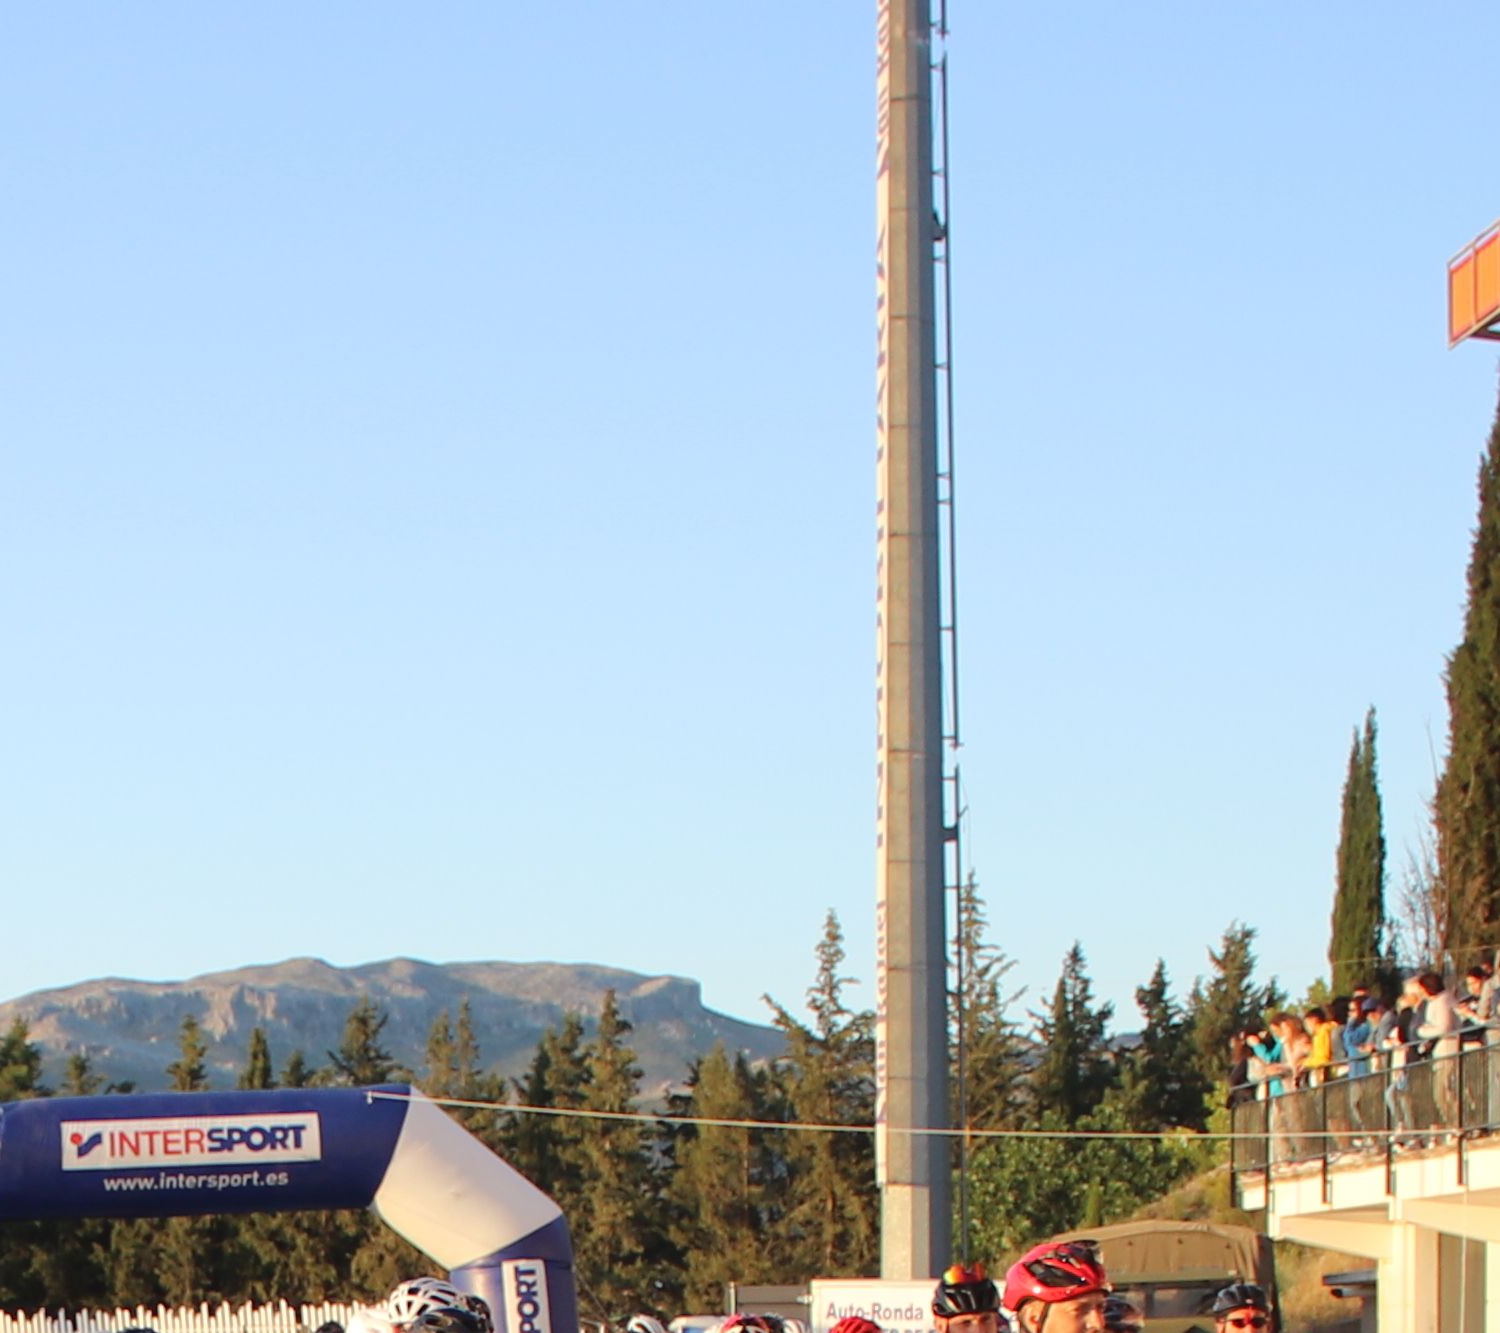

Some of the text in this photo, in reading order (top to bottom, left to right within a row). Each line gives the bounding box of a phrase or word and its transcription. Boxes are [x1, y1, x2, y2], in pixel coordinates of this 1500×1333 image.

[109, 1125, 307, 1159] INTERSPORT
[103, 1171, 290, 1193] www.intersport.es
[826, 1302, 924, 1322] Auto-Ronda
